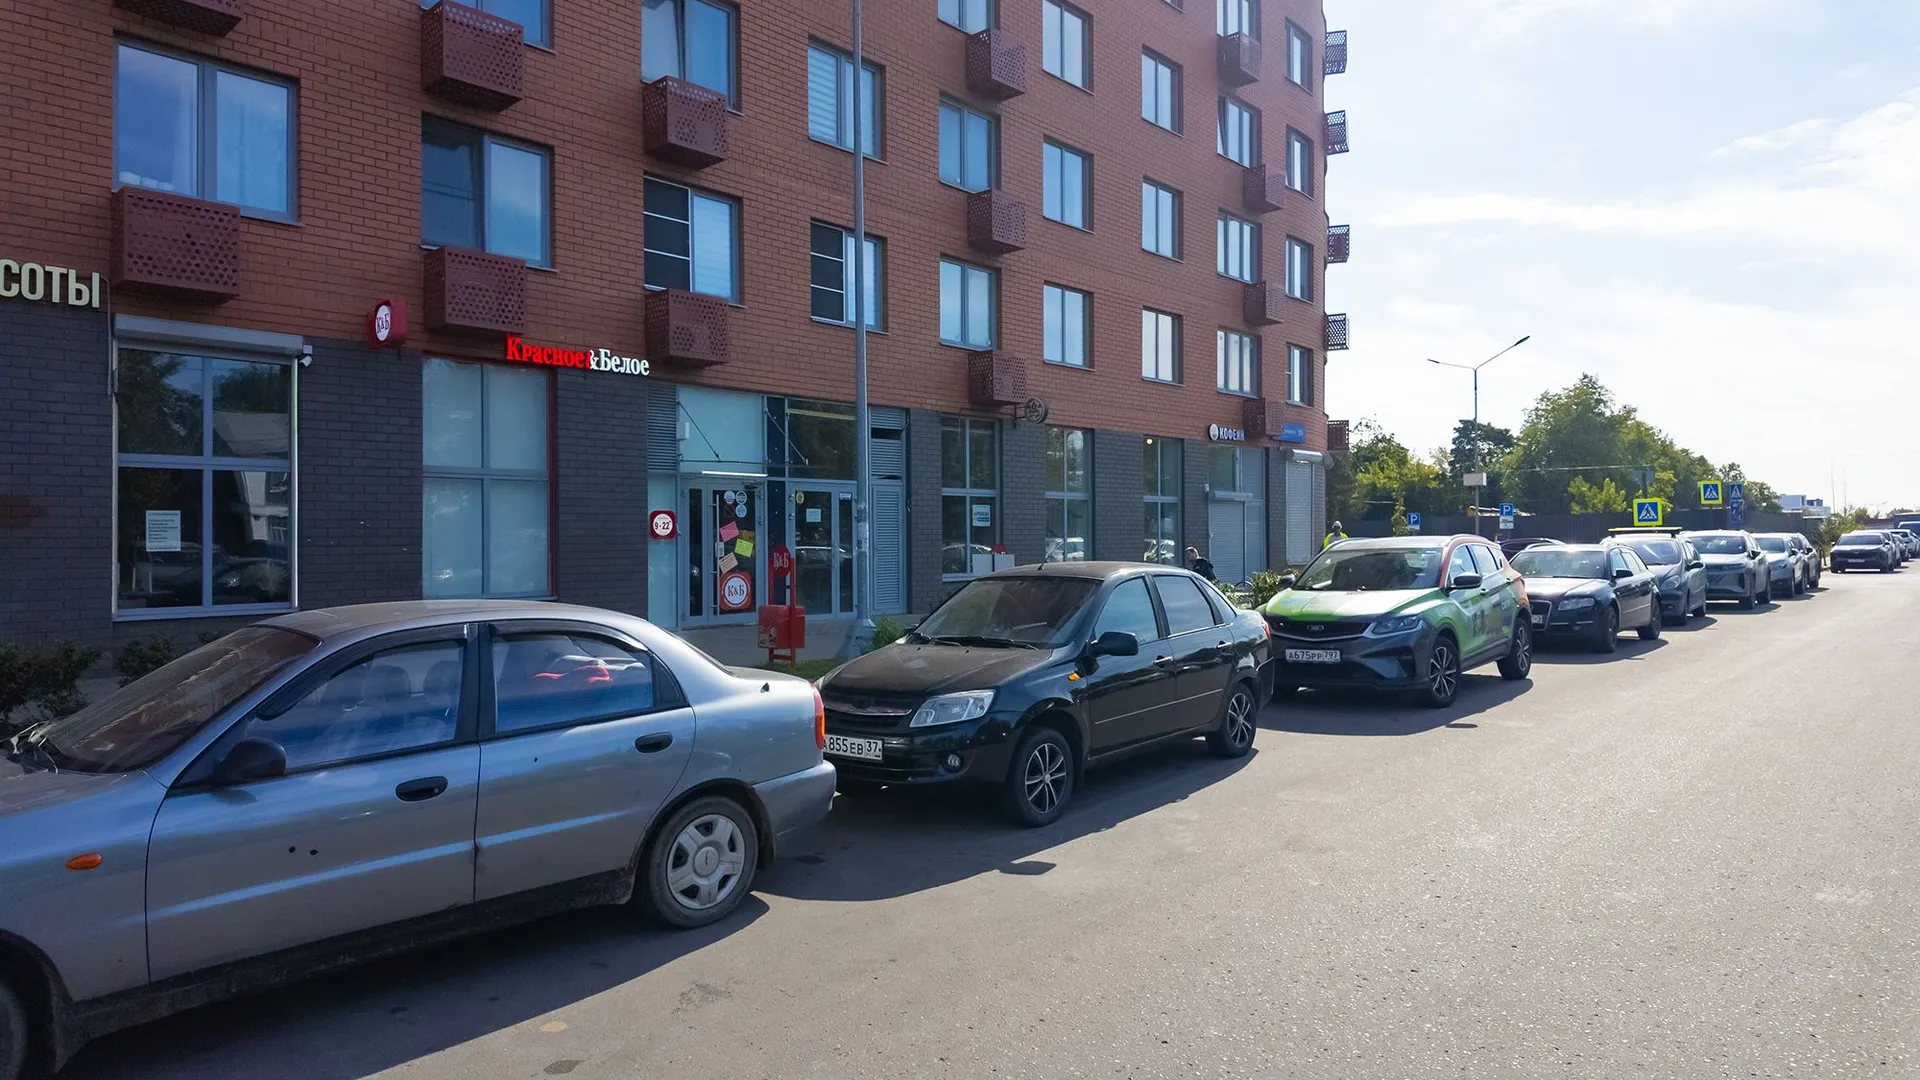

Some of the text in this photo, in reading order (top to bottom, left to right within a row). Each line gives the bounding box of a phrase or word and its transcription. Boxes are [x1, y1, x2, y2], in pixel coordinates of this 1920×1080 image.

[0, 259, 100, 308] СОТЫ
[506, 335, 650, 376] Красное&Белое
[727, 585, 744, 597] К&Б
